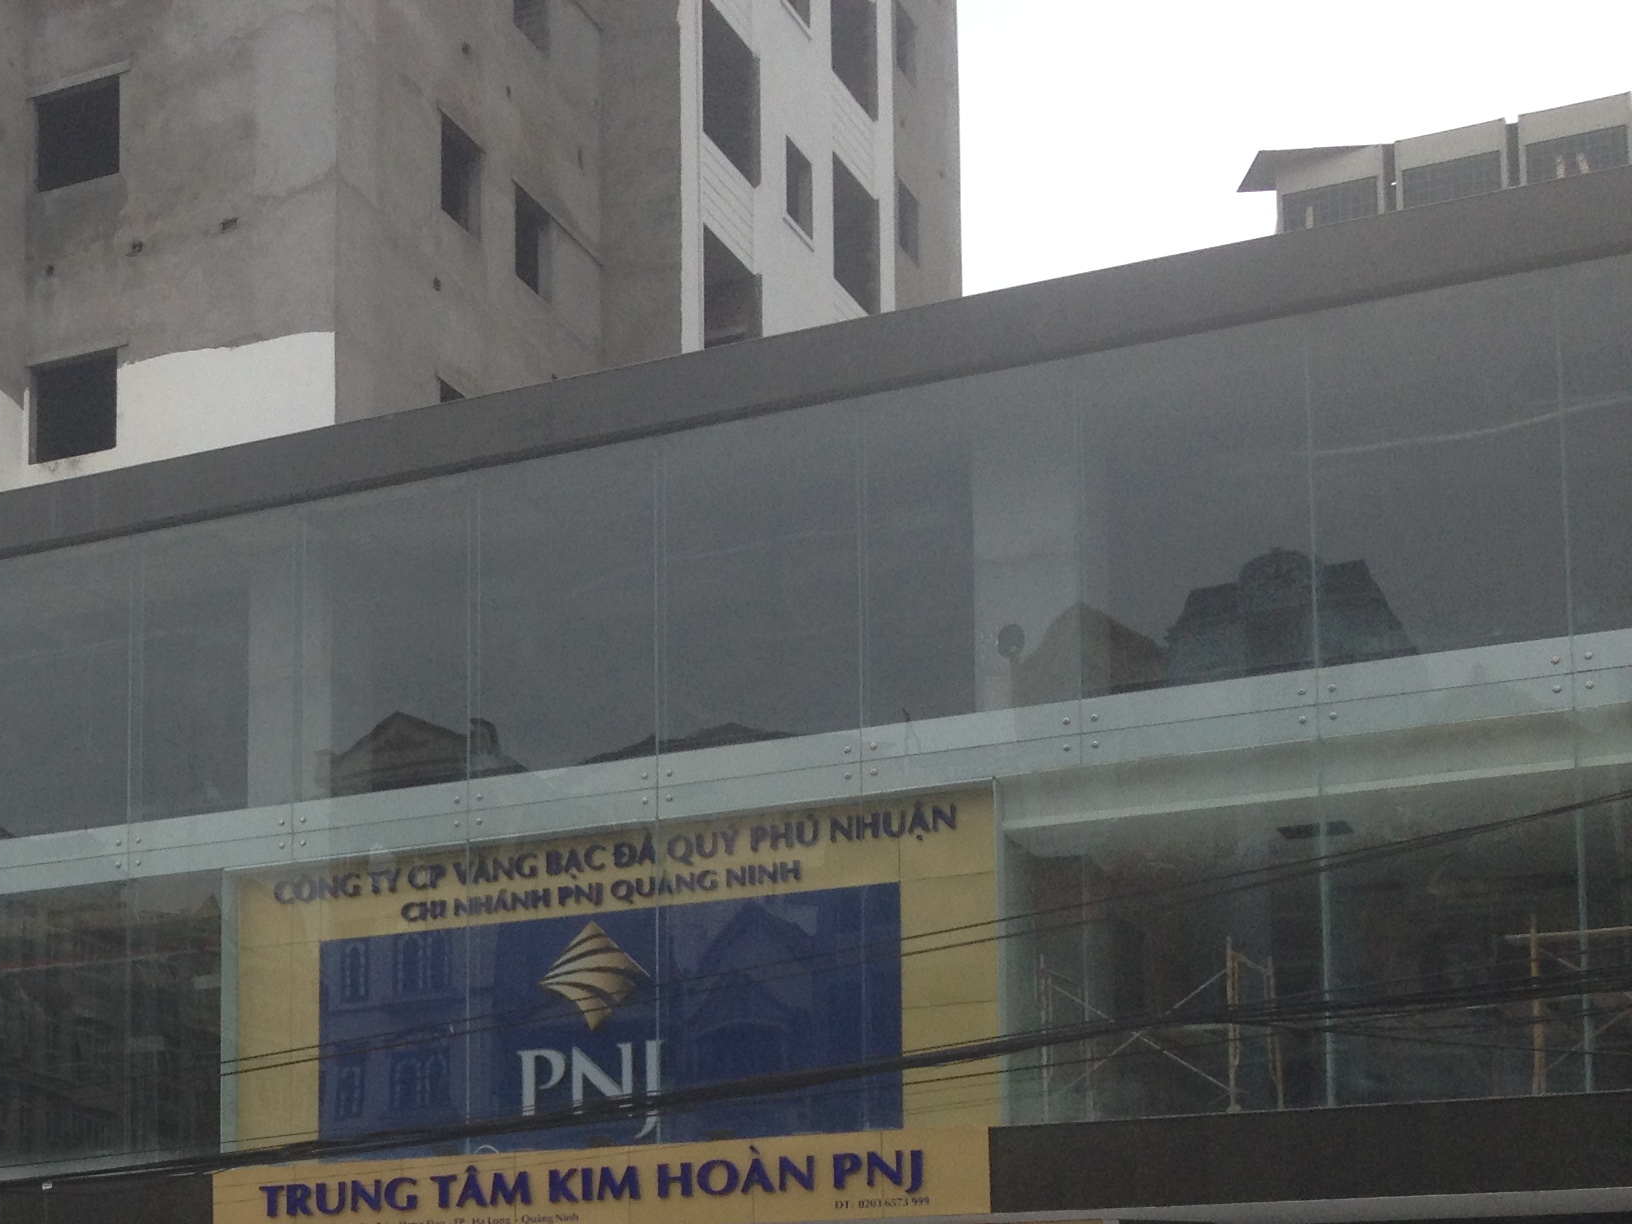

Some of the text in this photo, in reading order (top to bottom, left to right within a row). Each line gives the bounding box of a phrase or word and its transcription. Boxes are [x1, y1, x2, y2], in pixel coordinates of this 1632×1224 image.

[272, 871, 362, 905] CÔNG
[367, 866, 402, 896] TY
[406, 862, 449, 892] CP
[545, 843, 607, 881] BẠC
[399, 899, 448, 924] CHI
[452, 886, 552, 917] NHÁNH
[556, 880, 604, 907] PNJ
[724, 859, 804, 889] NINH
[517, 1038, 665, 1139] PNJ
[259, 1144, 925, 1218] TRUNG TÂM KIM HOÀN PNJ
